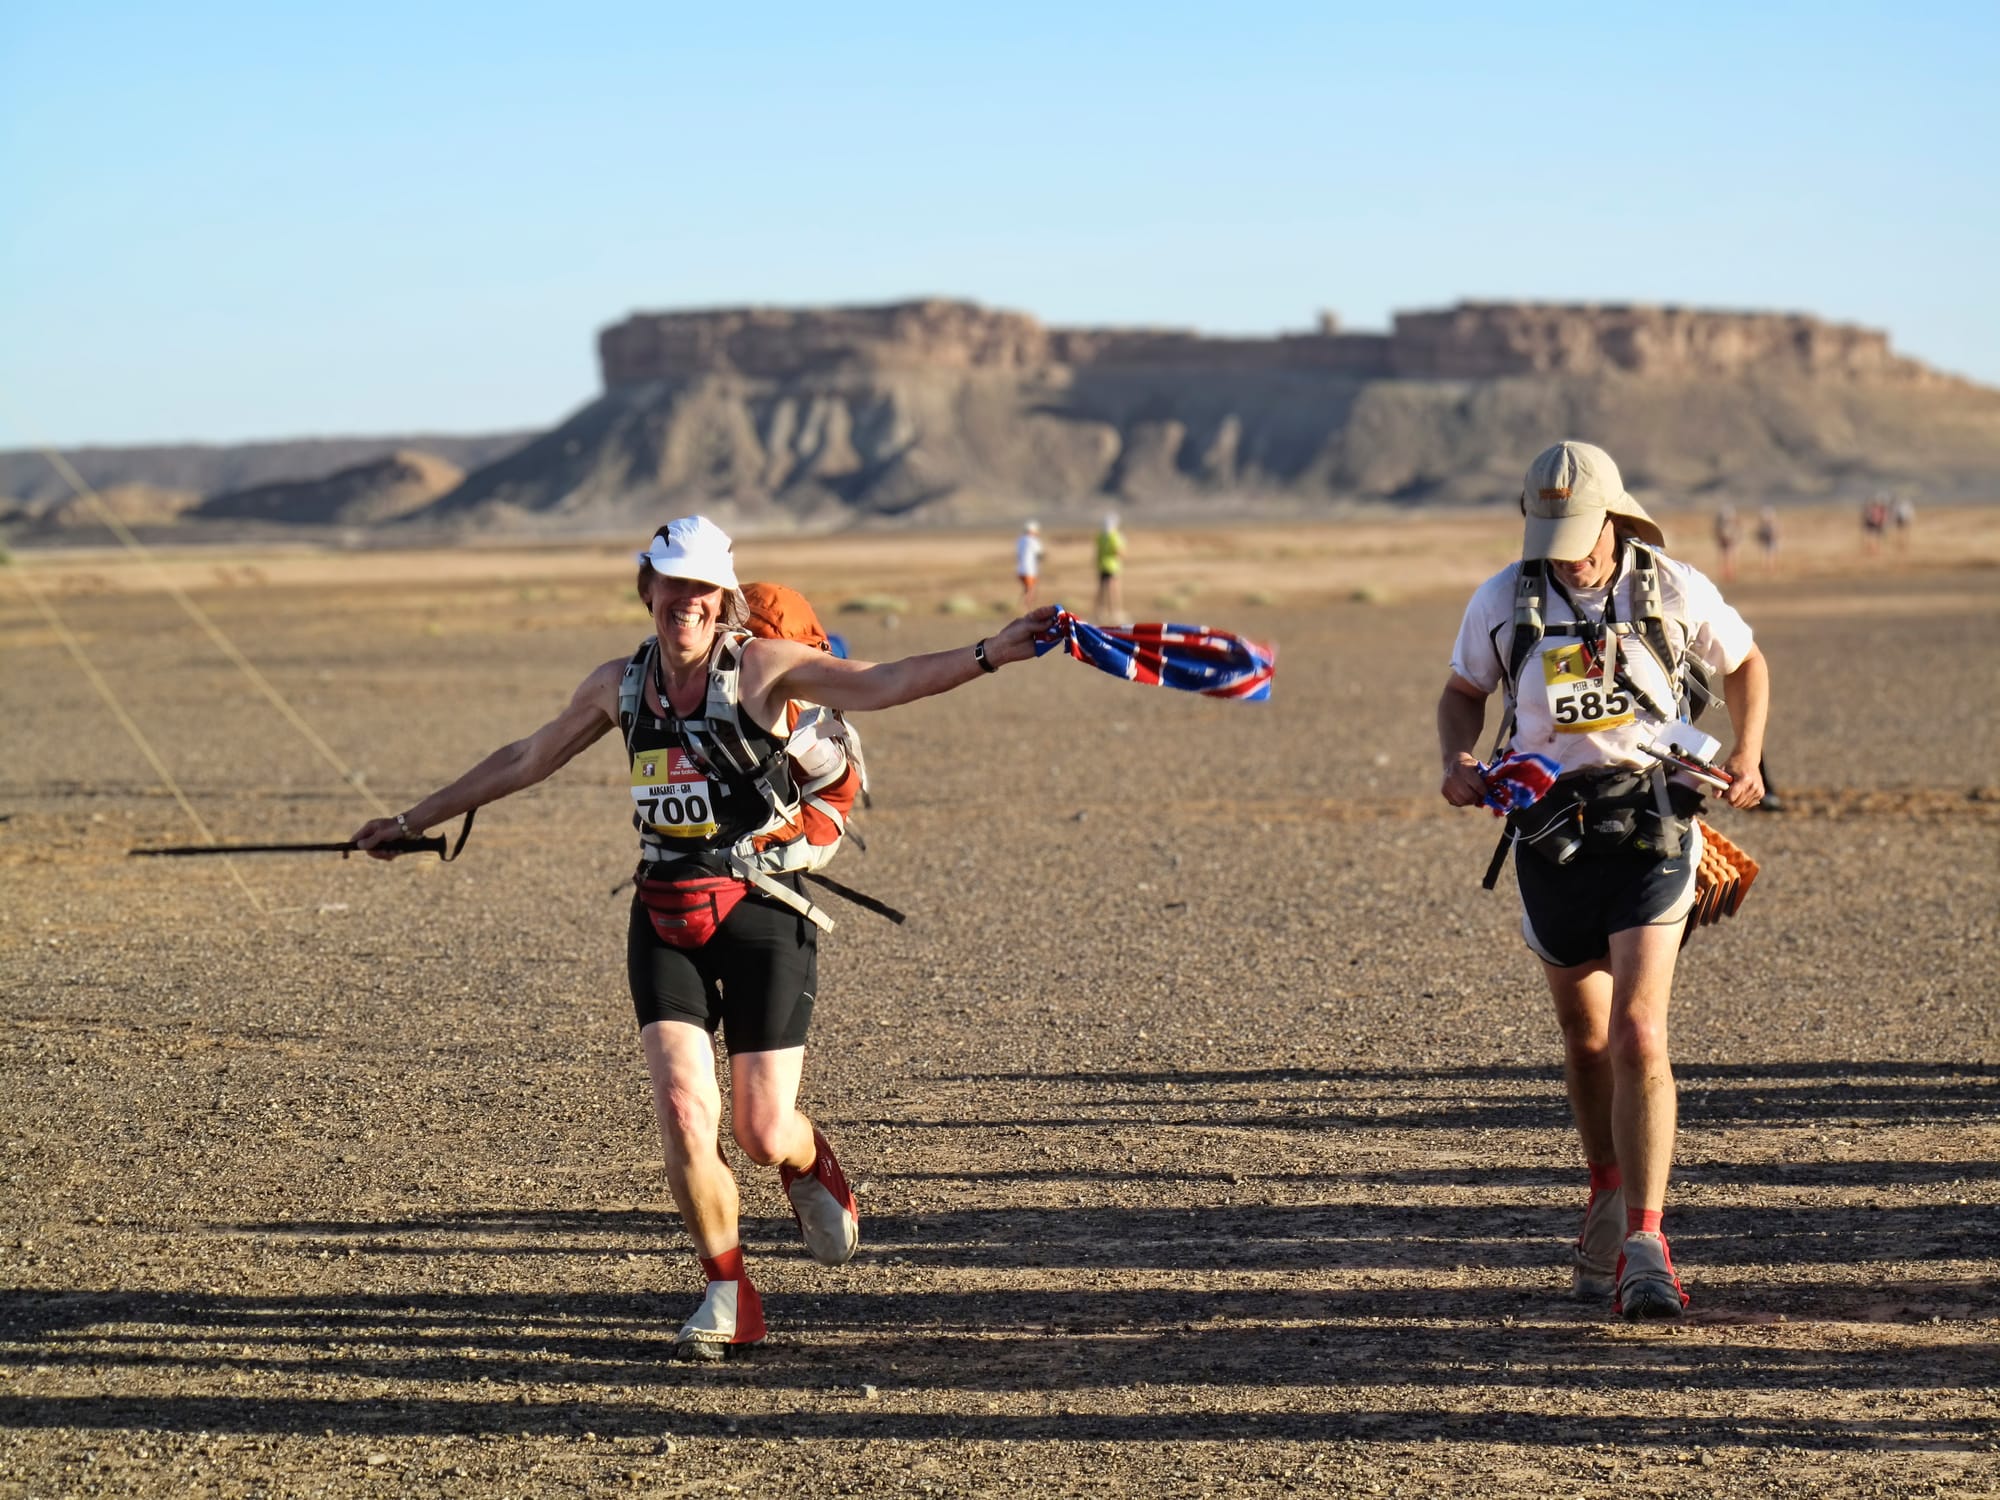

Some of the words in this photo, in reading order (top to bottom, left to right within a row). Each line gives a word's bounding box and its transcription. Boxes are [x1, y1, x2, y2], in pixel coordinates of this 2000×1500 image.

[1572, 681, 1589, 692] PETER
[1556, 687, 1629, 724] 585
[649, 785, 676, 796] MARGARET
[637, 795, 708, 825] 700
